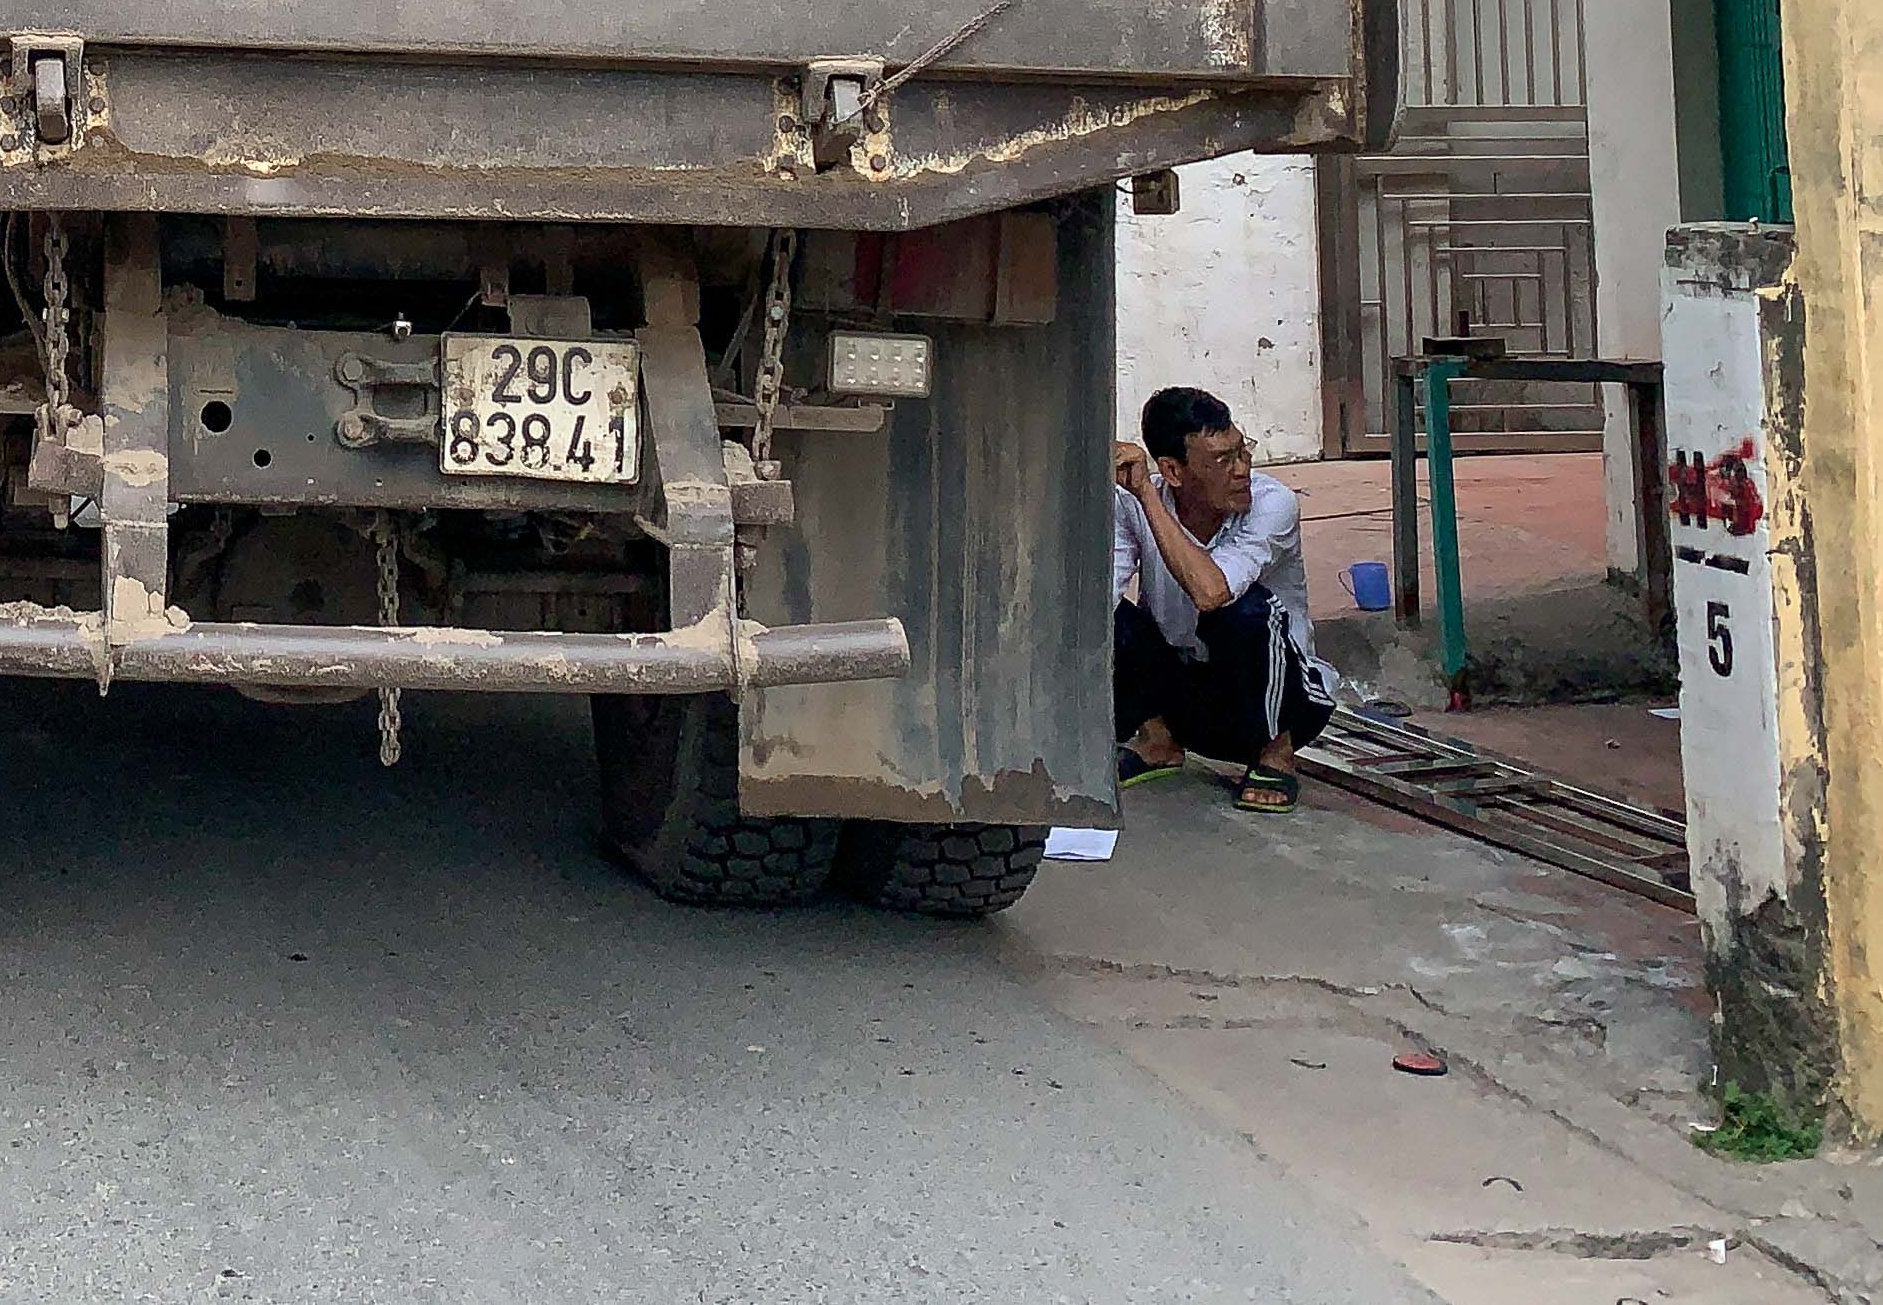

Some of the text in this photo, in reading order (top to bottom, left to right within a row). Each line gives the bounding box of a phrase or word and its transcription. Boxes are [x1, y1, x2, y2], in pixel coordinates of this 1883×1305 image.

[491, 344, 594, 406] 29C
[449, 409, 625, 474] 838.41
[1706, 601, 1733, 677] 5
